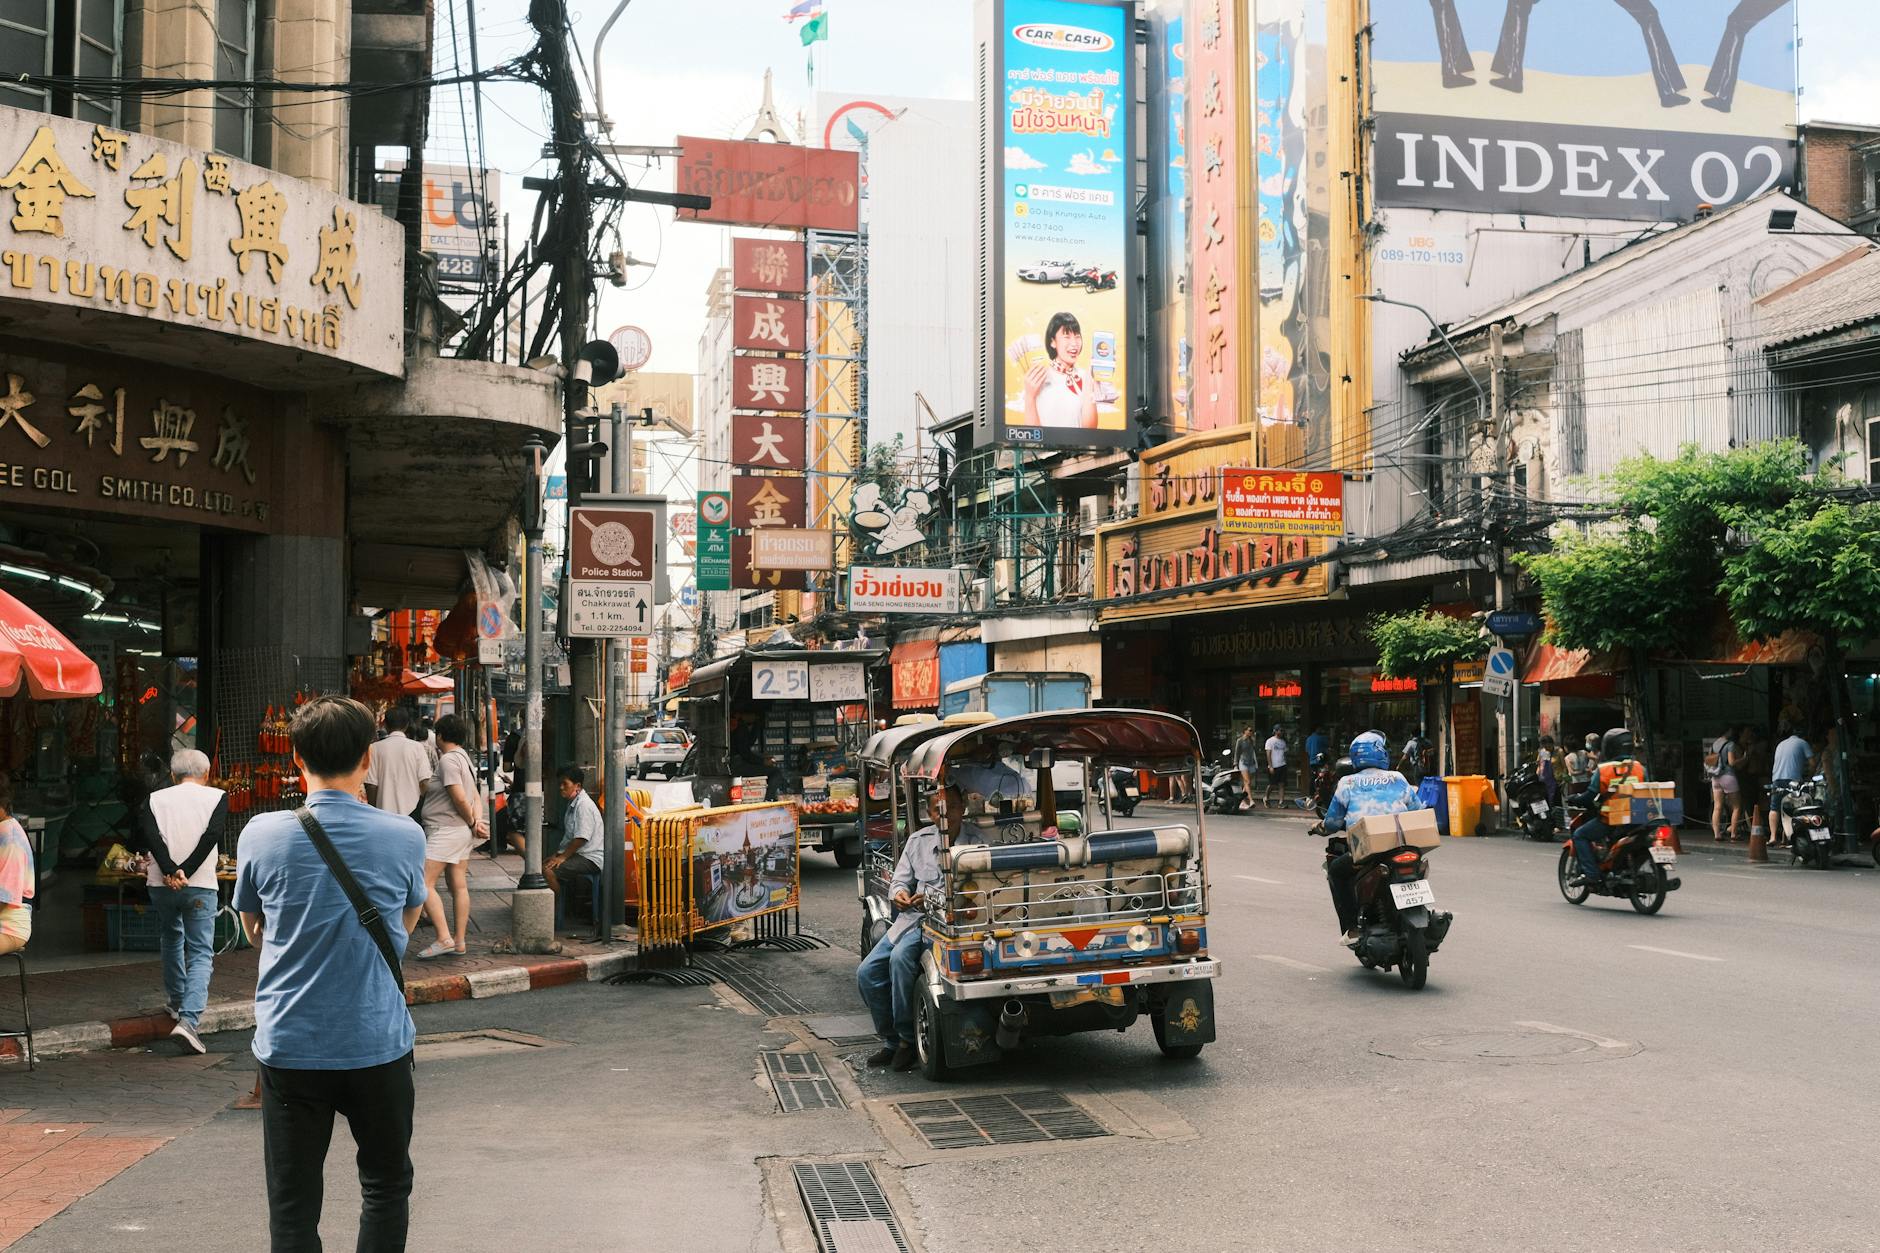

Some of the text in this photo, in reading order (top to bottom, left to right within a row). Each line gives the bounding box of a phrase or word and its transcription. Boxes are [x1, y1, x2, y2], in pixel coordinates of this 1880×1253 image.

[1025, 28, 1053, 39] CAR
[1065, 33, 1101, 45] CASH
[1013, 108, 1108, 131] มีใช้วันหน้า
[1396, 132, 1671, 202] INDEX
[1408, 236, 1436, 248] UBG
[1380, 249, 1464, 264] 089-170-1133
[102, 475, 163, 503] SMITH
[707, 544, 724, 552] ATM
[581, 567, 643, 578] Police Station
[581, 599, 631, 608] Chakkrawat
[591, 612, 605, 621] 1.1
